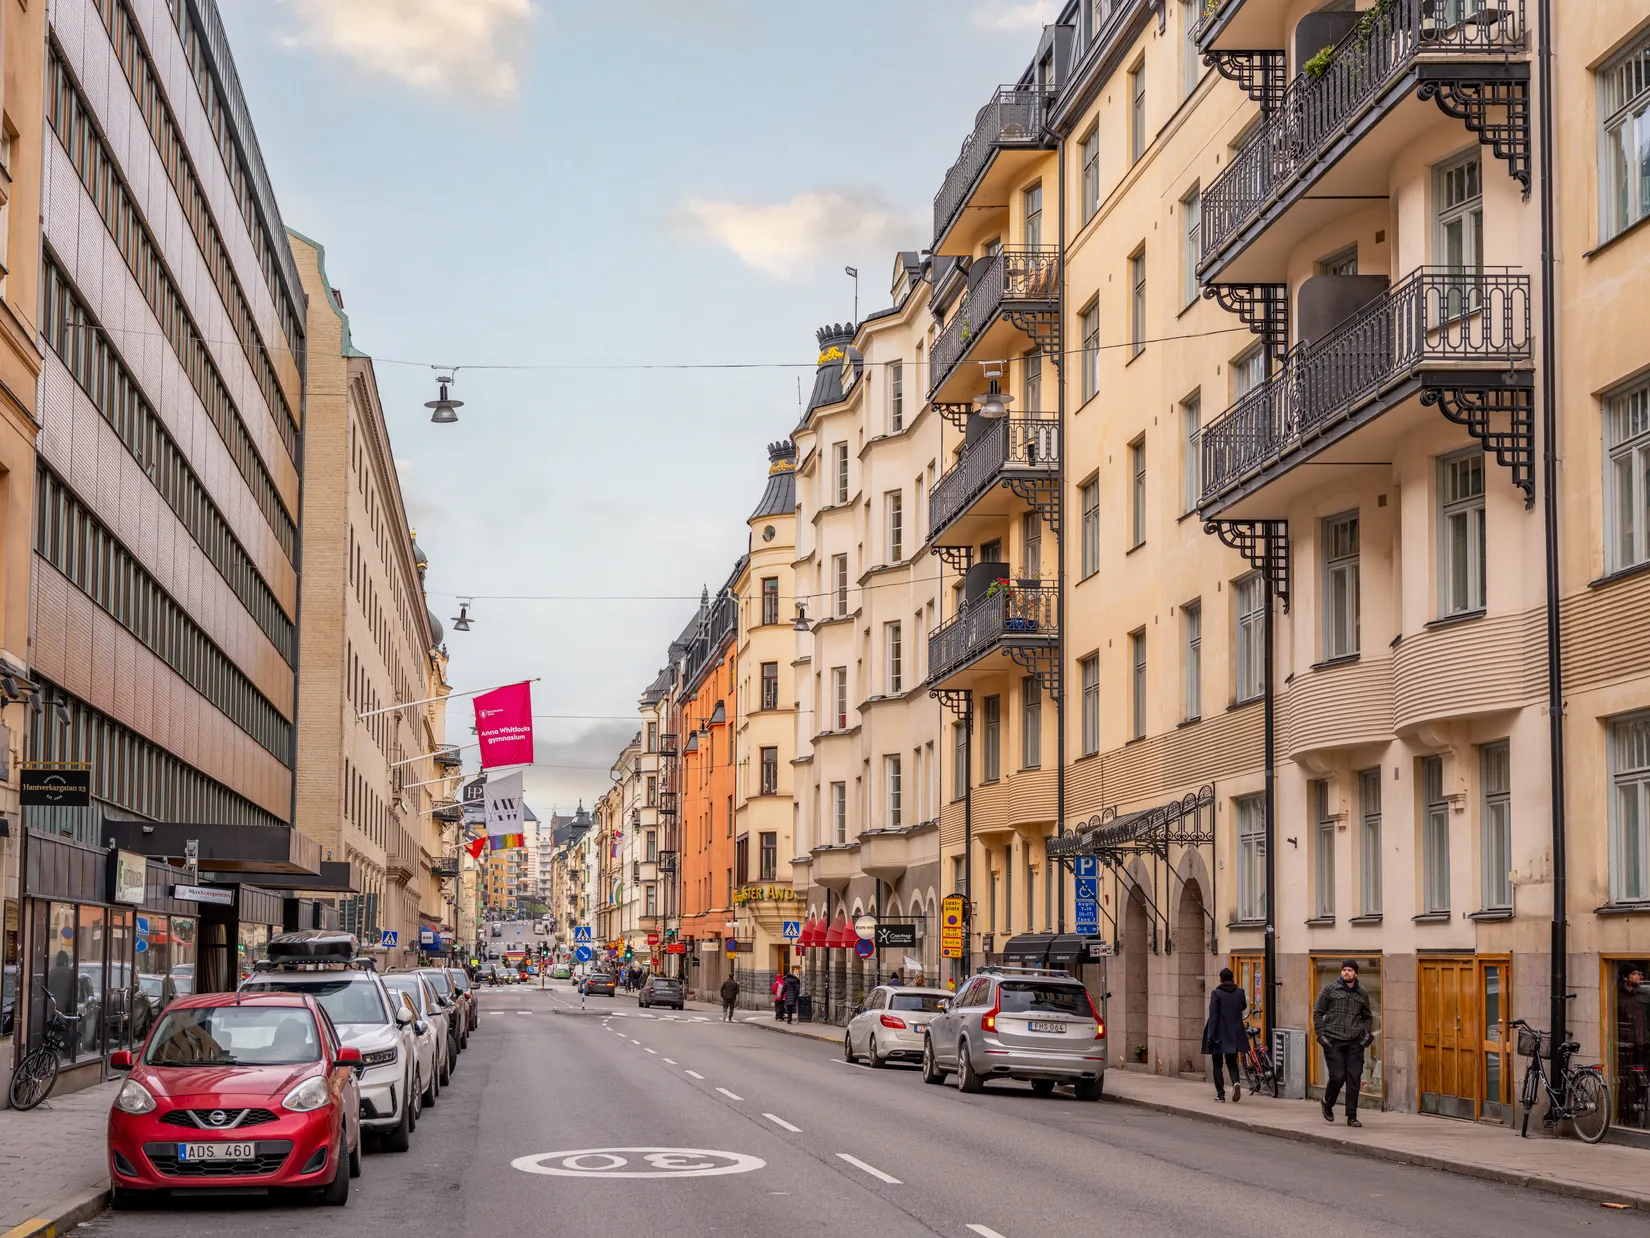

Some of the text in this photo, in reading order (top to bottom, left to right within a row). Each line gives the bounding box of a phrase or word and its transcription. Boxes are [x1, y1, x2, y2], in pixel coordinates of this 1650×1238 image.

[499, 726, 531, 734] Whitlocks
[488, 734, 526, 745] gymnasium
[23, 783, 87, 793] Hantverkargatan 23
[188, 1145, 251, 1158] ADS 460
